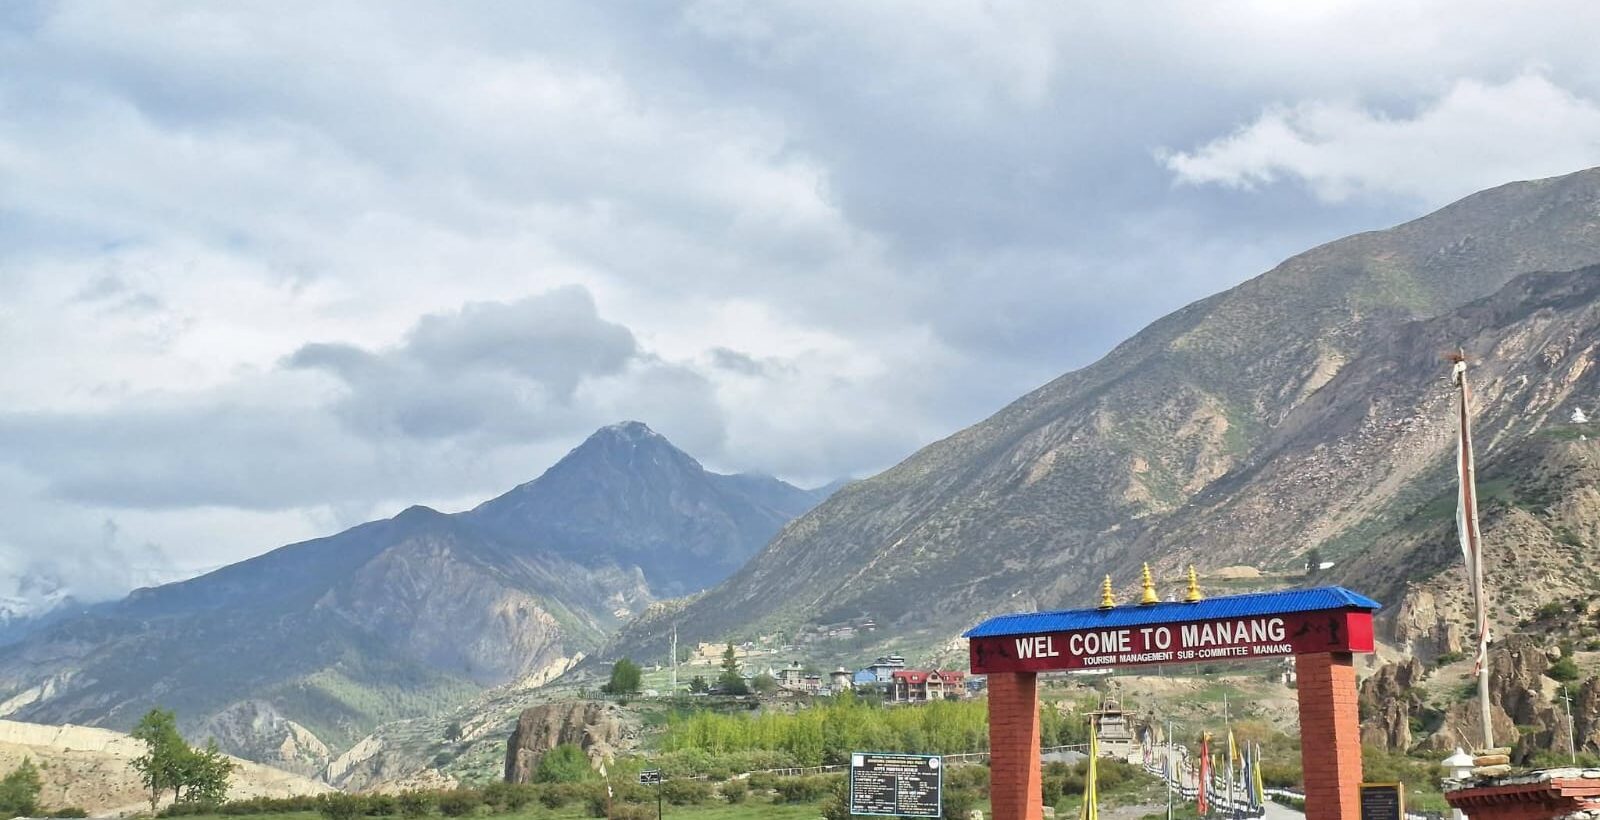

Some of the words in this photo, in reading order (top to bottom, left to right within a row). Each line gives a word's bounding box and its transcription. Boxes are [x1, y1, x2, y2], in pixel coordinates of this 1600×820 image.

[1015, 637, 1059, 659] WEL
[1069, 630, 1131, 656] COME
[1140, 627, 1171, 650] TO
[1181, 617, 1286, 648] MANANG
[1083, 655, 1117, 666] TOURISM
[1119, 652, 1174, 663] MANAGEMENT
[1177, 647, 1248, 660] SUB-COMMITTEE
[1253, 644, 1292, 654] MANANG
